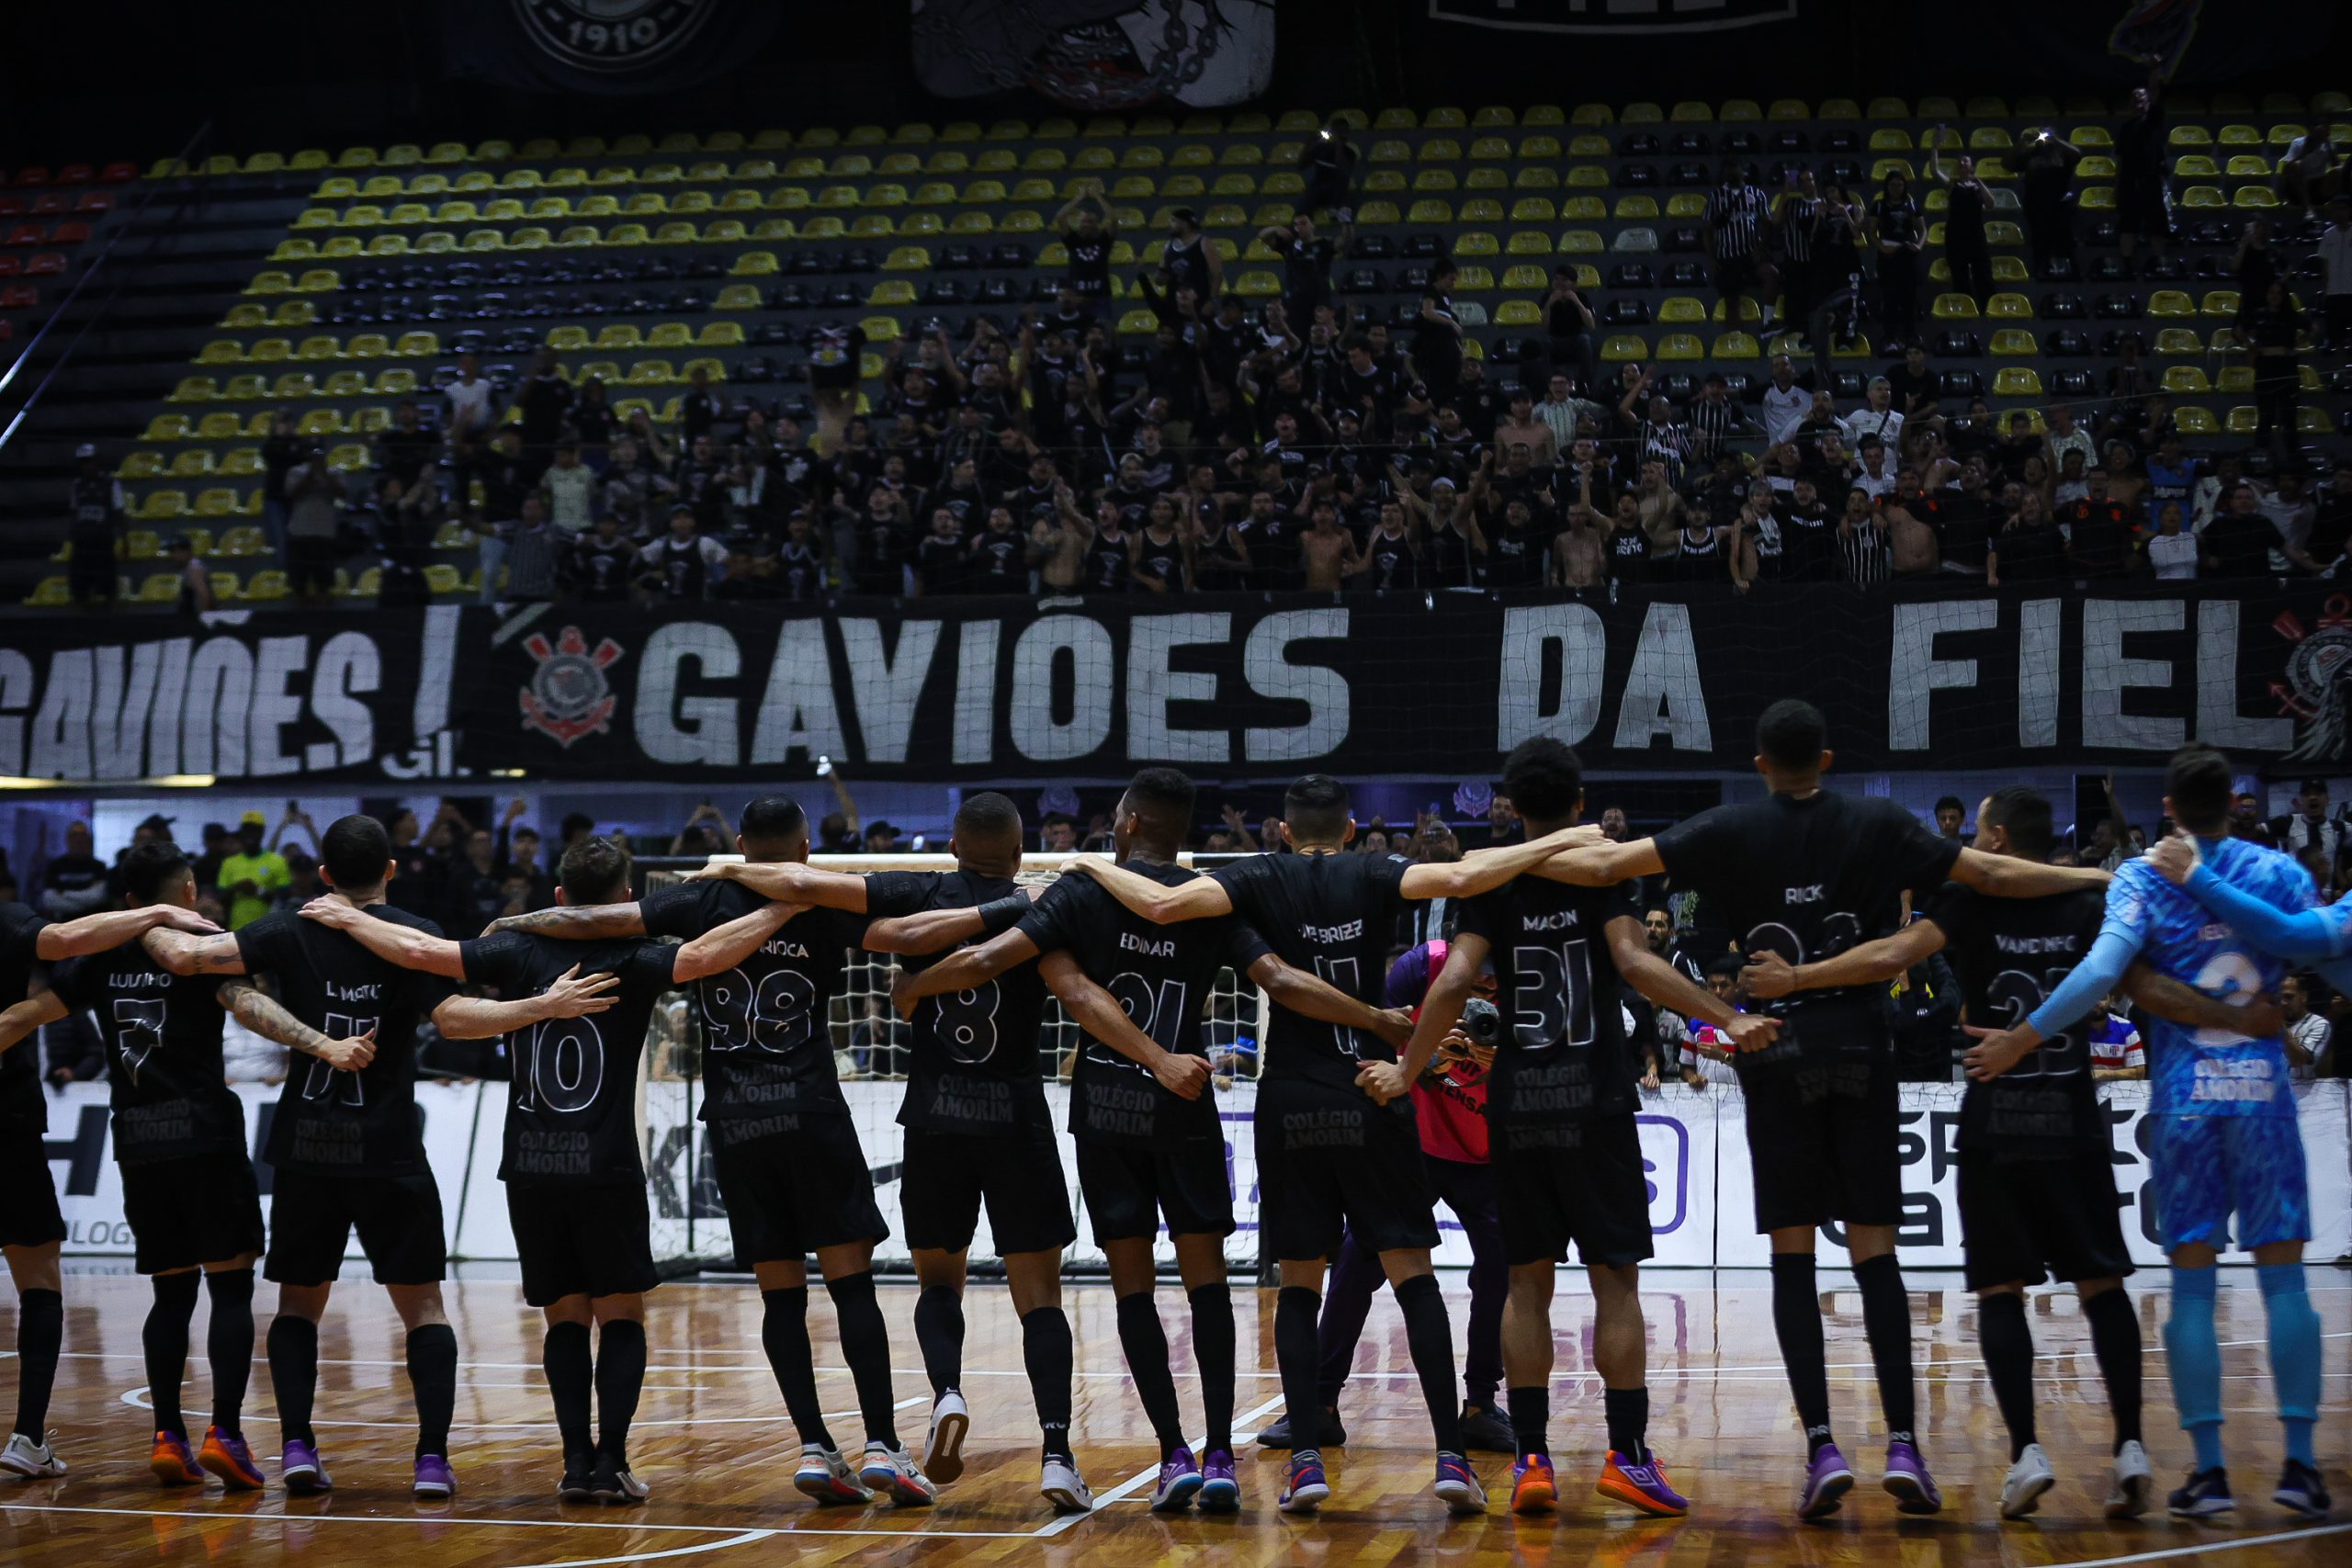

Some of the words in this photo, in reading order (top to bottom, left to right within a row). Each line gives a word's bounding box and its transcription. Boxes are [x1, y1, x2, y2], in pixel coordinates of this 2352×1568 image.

[567, 17, 659, 52] 1910
[633, 595, 1351, 765] GAVIÕES
[1497, 602, 1713, 753] DA
[1889, 597, 2295, 751] FIEL
[1785, 885, 1825, 905] RICK
[757, 939, 809, 959] RIOCA
[1513, 937, 1597, 1050] 31
[700, 967, 816, 1054] 98
[933, 976, 1001, 1064] 8
[511, 1015, 605, 1113] 10
[930, 1094, 1014, 1122] AMORIM
[1511, 1084, 1594, 1111] AMORIM
[722, 1113, 801, 1146] AMORIM
[1087, 1106, 1155, 1137] MORIM
[1283, 1128, 1365, 1150] AMORIM
[514, 1151, 591, 1175] AMORIM
